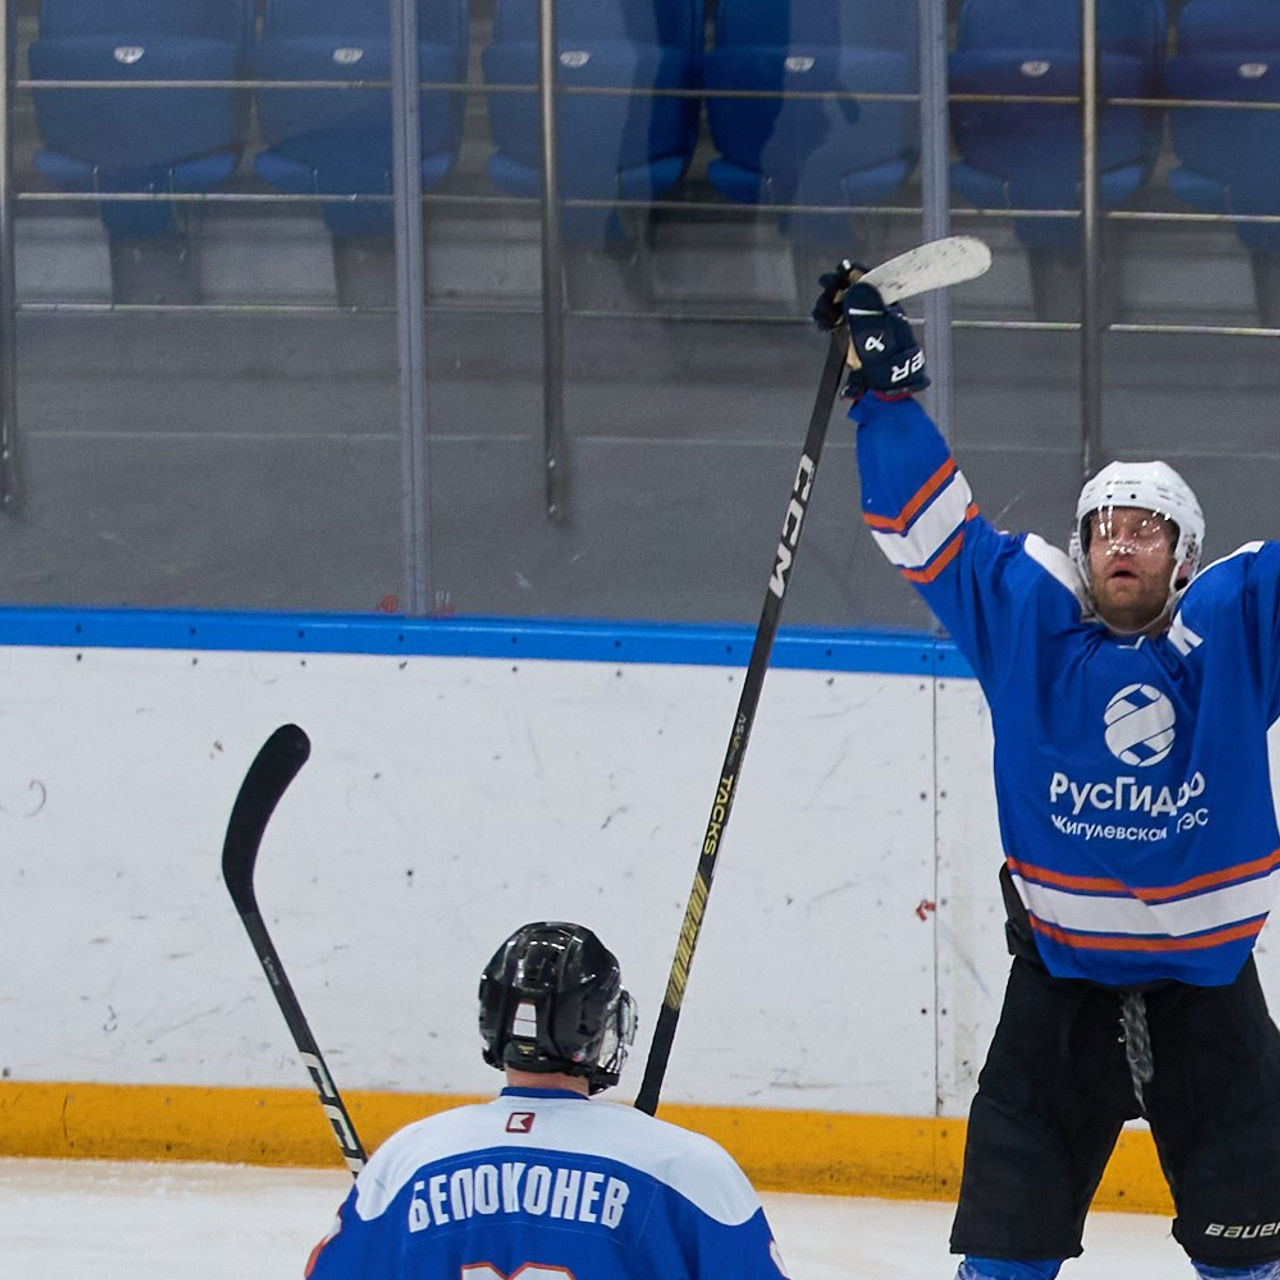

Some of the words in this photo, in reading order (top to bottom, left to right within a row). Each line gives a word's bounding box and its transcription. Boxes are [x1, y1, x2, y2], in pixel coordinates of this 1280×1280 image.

[769, 453, 815, 598] CCM
[703, 774, 734, 856] TACKS
[1050, 771, 1206, 817] РусГидро
[1051, 813, 1168, 842] Жигулевская
[1176, 807, 1209, 834] ГЭС
